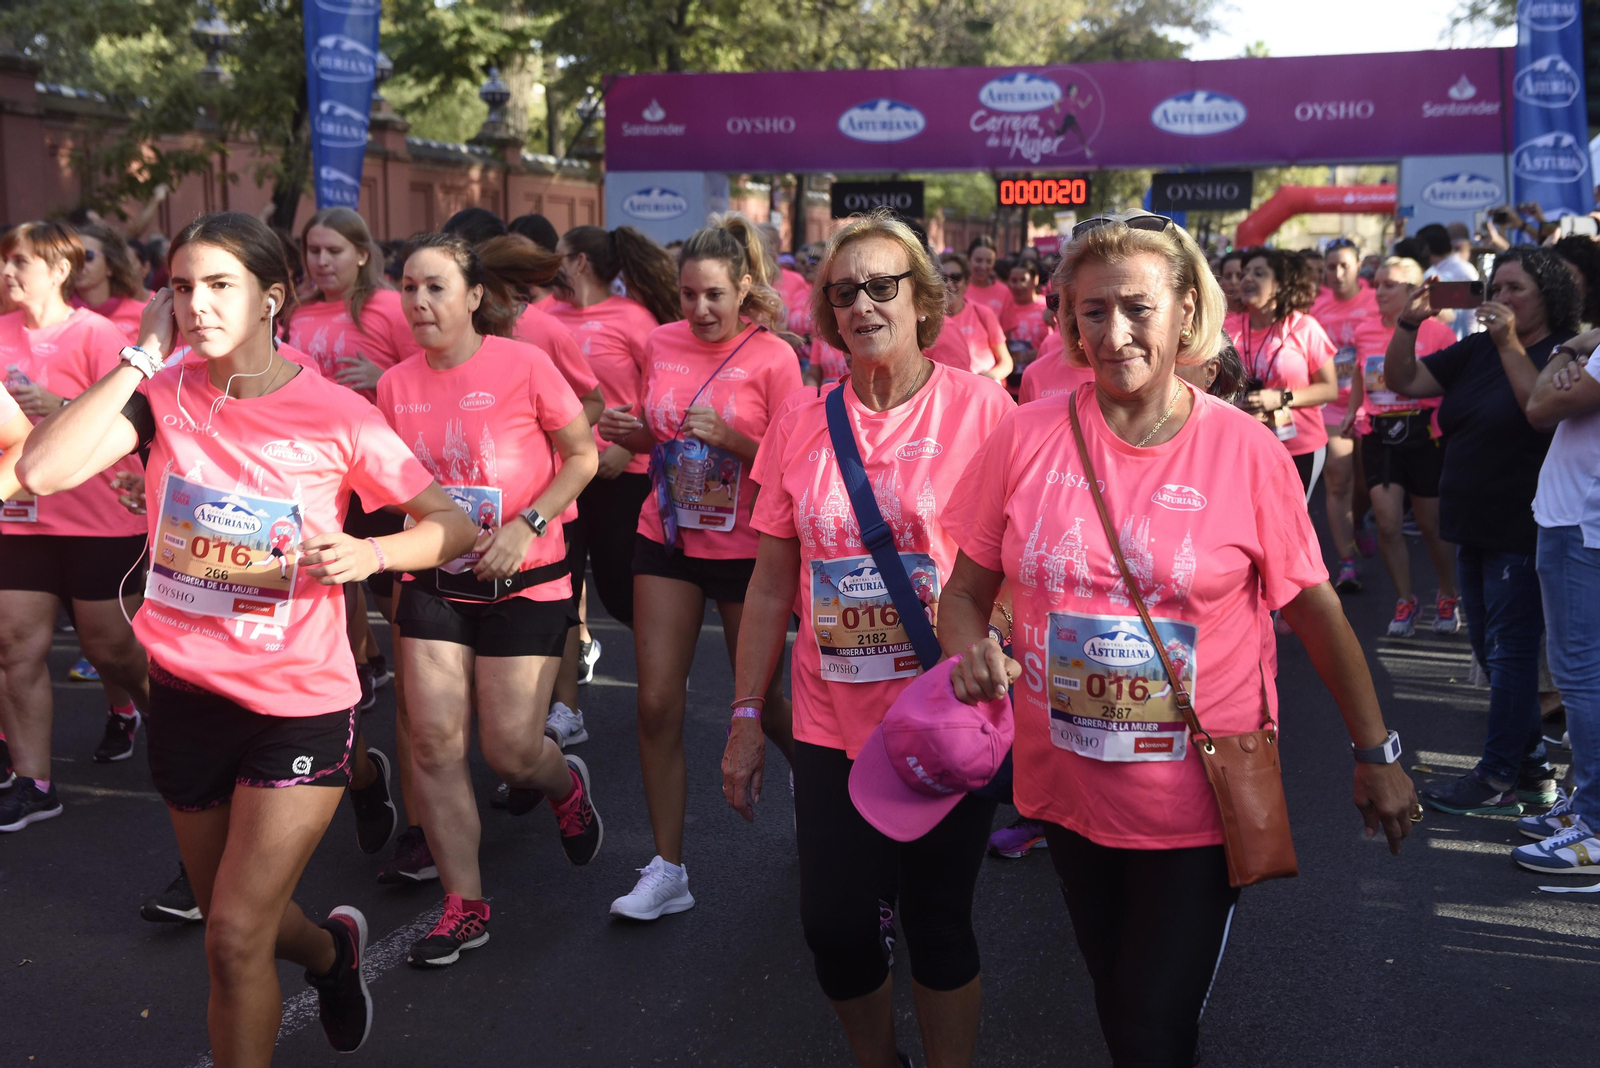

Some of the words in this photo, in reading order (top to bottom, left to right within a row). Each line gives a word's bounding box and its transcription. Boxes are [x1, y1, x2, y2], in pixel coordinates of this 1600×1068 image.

[986, 88, 1056, 103] ASTURIANA
[1158, 110, 1240, 125] ASTURIANA
[1295, 100, 1374, 121] OYSHO
[1422, 101, 1500, 118] Santander
[622, 122, 686, 136] Santander
[726, 116, 796, 134] OYSHO
[846, 116, 919, 131] ASTURIANA
[970, 109, 1042, 132] Carrera
[1010, 132, 1066, 163] Mujer
[1166, 182, 1239, 200] OYSHO
[844, 192, 912, 210] OYSHO
[654, 360, 690, 375] OYSHO
[394, 403, 432, 414] OYSHO
[462, 398, 493, 407] ASTURIANA
[163, 414, 218, 438] OYSHO
[265, 444, 314, 463] ASTURIANA
[900, 446, 940, 457] ASTURIANA
[1154, 490, 1202, 508] ASTURIANA
[196, 508, 256, 532] ASTURIANA
[191, 536, 252, 568] 016
[204, 566, 229, 581] 266
[172, 572, 205, 588] CARRERA
[206, 580, 217, 590] DE
[220, 582, 230, 592] LA
[232, 584, 260, 596] MUJER
[842, 580, 887, 592] ASTURIA
[158, 583, 195, 604] OYSHO
[146, 608, 177, 627] ARRERA
[178, 621, 190, 632] DE
[190, 624, 200, 634] LA
[202, 628, 230, 642] MUJER
[842, 604, 900, 630] 016
[857, 632, 888, 646] 2182
[836, 648, 864, 656] CARRERA
[866, 646, 876, 654] DE
[878, 646, 888, 654] LA
[889, 642, 914, 652] MUJER
[1088, 642, 1150, 660] ASTURIANA
[828, 662, 858, 674] OYSHO
[1086, 673, 1150, 702] 016
[1026, 694, 1048, 711] CARRER
[1102, 706, 1132, 720] 2587
[1072, 716, 1107, 730] CARRERA
[1108, 721, 1118, 731] DE
[1119, 722, 1128, 731] LA
[1131, 722, 1159, 732] MUJER
[1061, 728, 1099, 748] OYSHO
[1144, 741, 1170, 749] Santander
